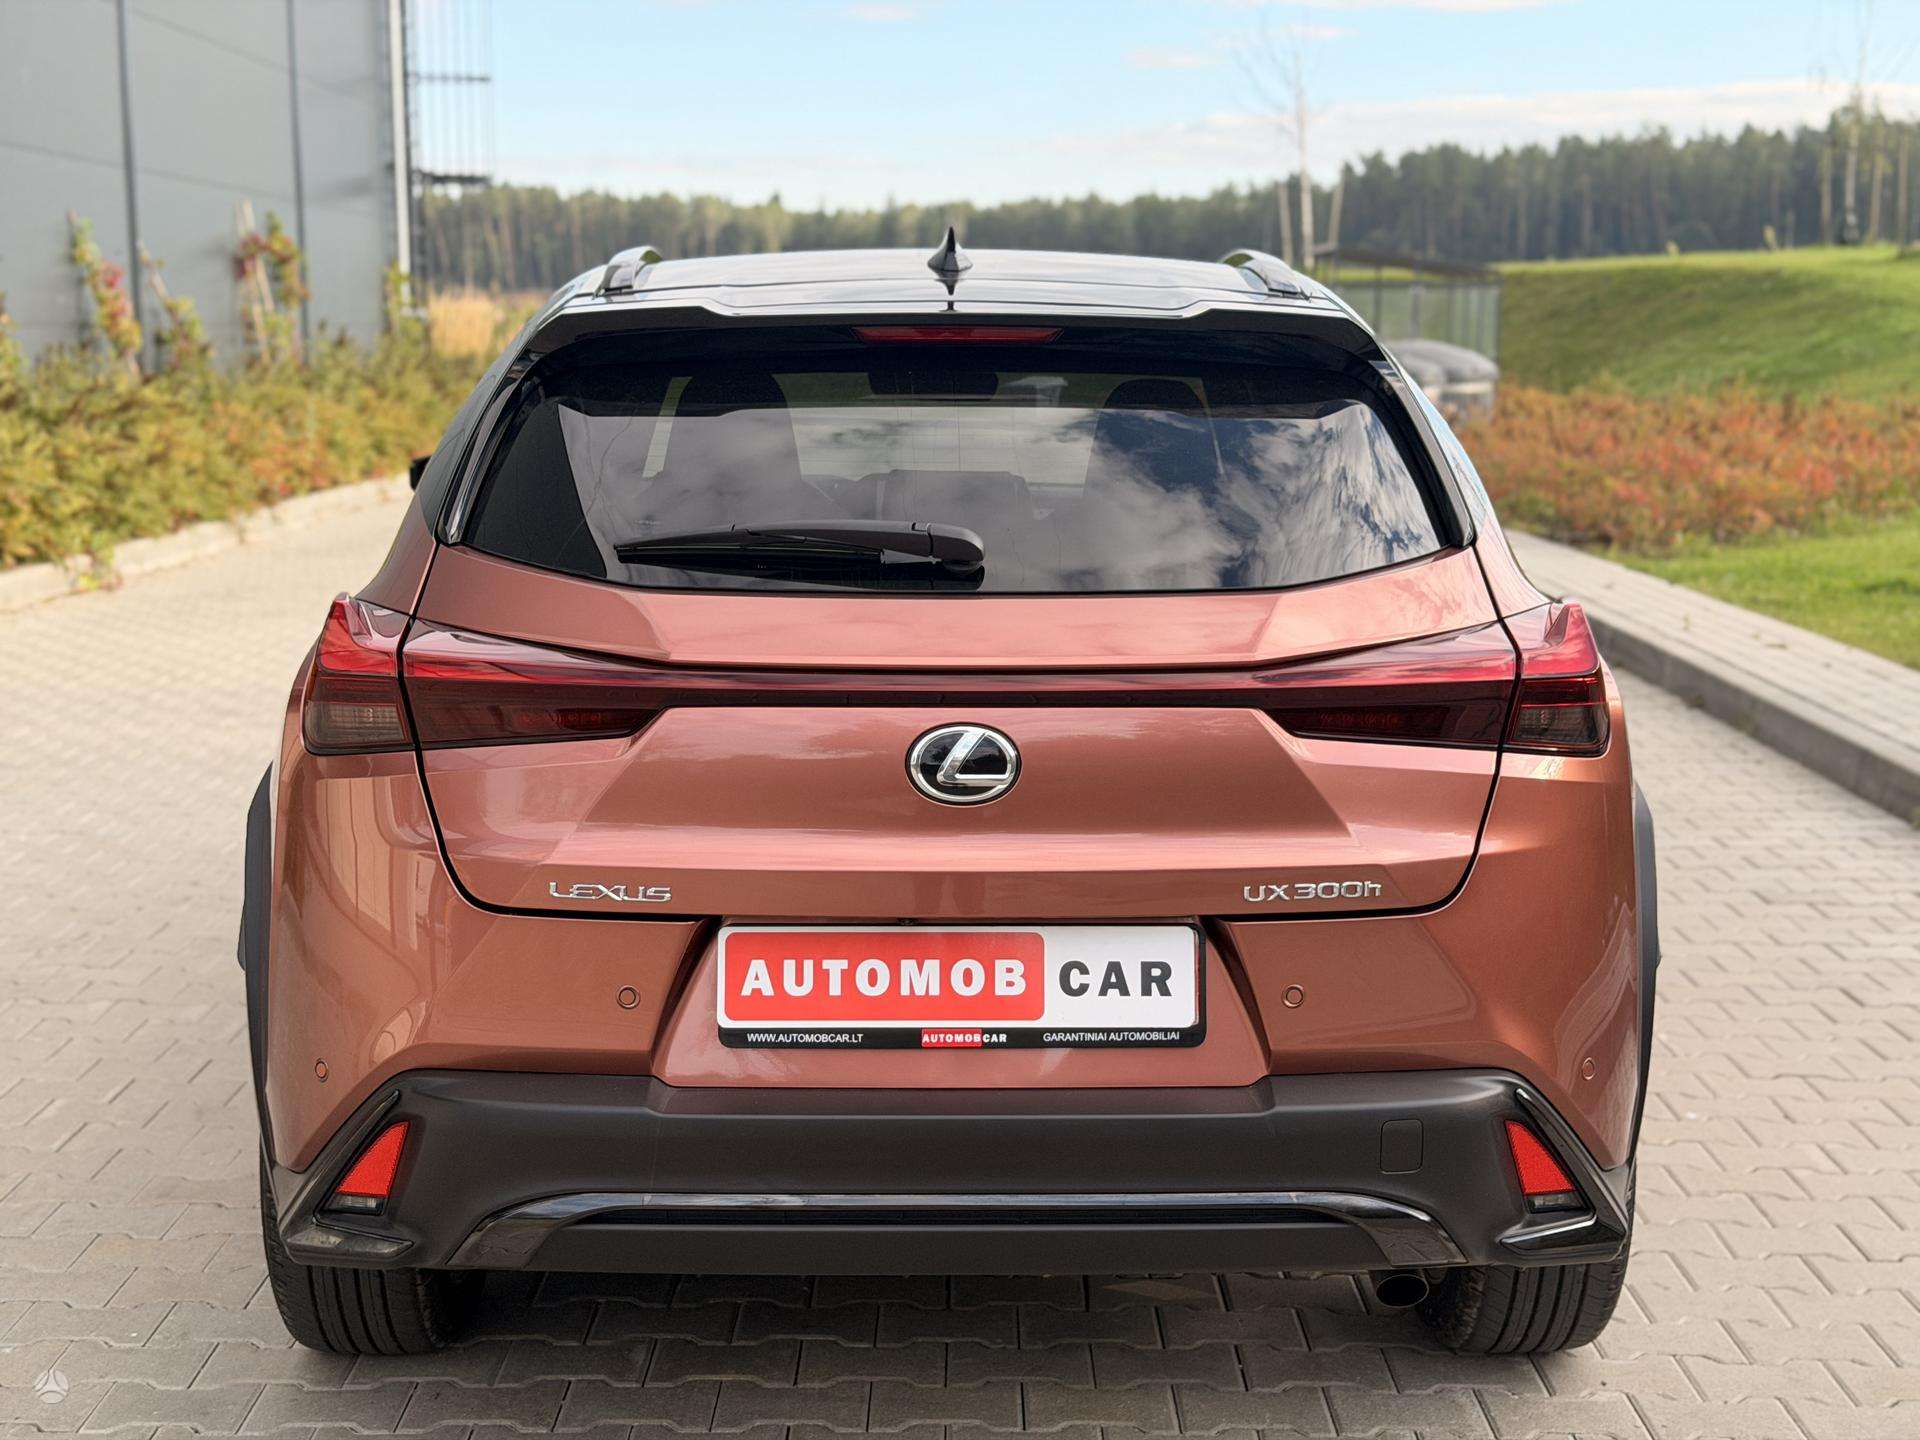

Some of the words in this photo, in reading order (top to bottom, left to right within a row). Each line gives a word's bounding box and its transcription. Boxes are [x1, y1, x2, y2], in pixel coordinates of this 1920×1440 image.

[548, 881, 672, 902] LEXUS
[740, 958, 1028, 997] AUTOMOB
[1058, 959, 1173, 998] CAR
[746, 1032, 865, 1043] WWW.AUTOMOBCAR.LT
[1042, 1032, 1107, 1042] GARANTINIAI
[1108, 1031, 1181, 1042] AUTOMOBILIAI
